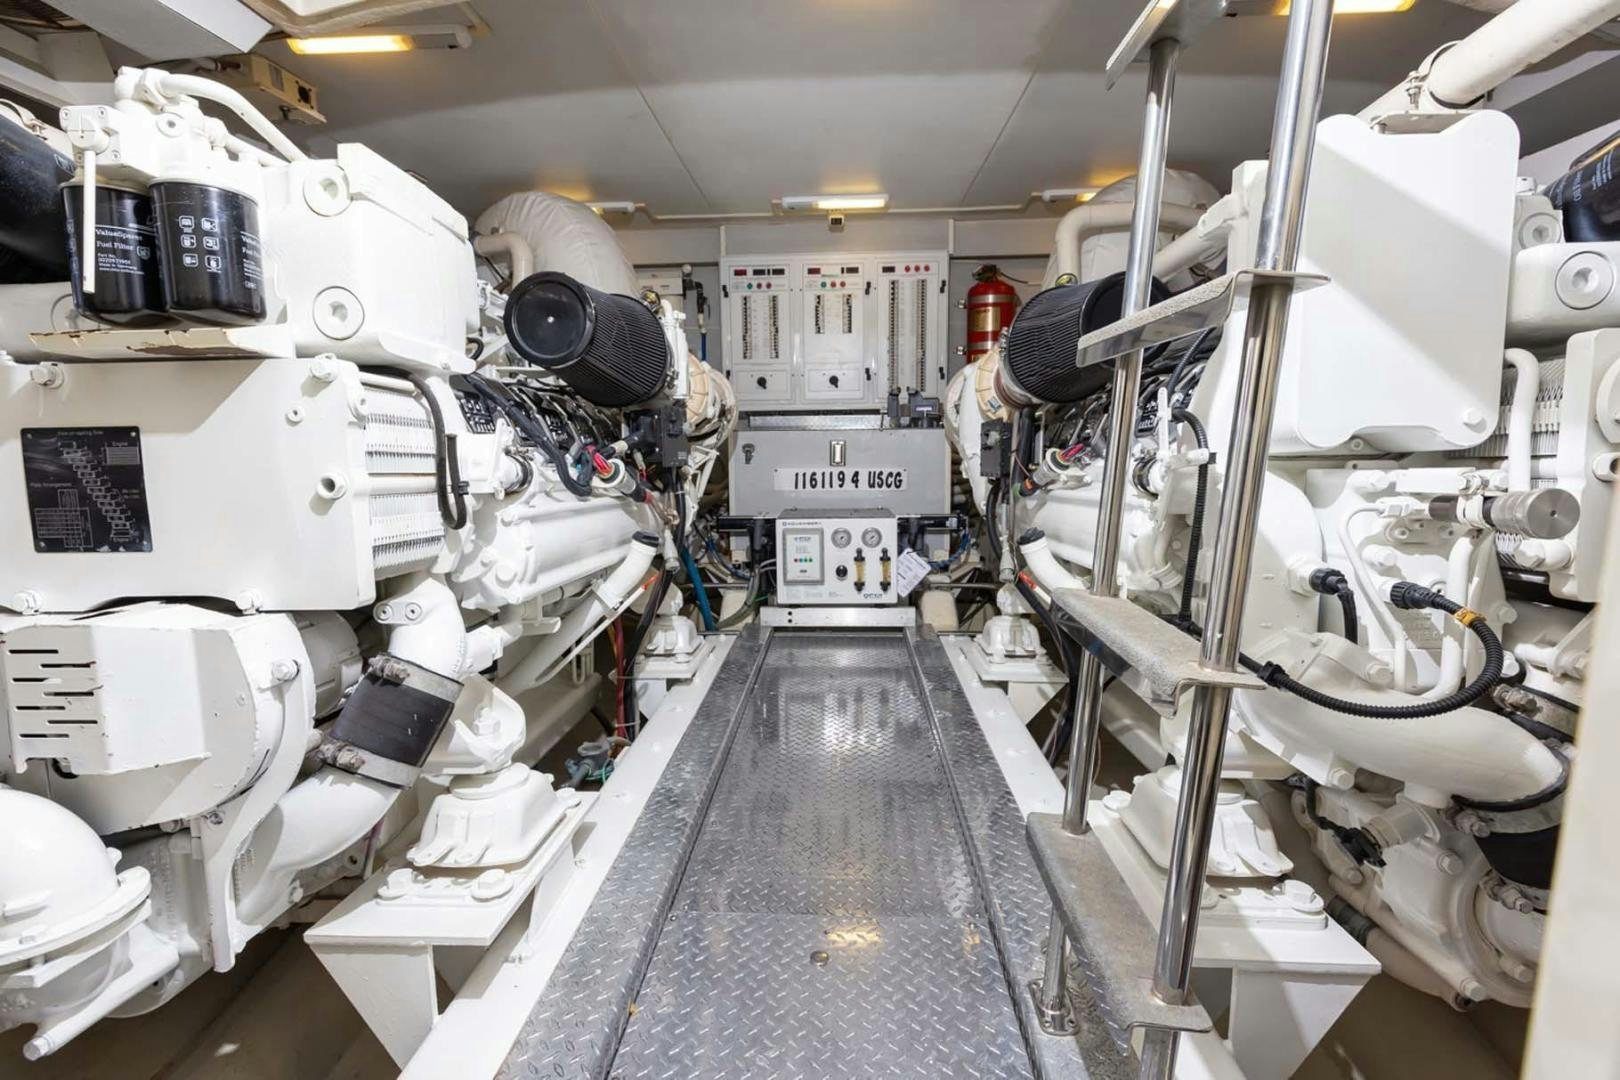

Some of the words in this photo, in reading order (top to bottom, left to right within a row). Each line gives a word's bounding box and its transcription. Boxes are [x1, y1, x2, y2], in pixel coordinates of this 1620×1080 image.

[96, 240, 113, 249] Fuel
[114, 242, 134, 251] Filter
[794, 470, 860, 490] 1161194
[867, 470, 903, 489] USCG
